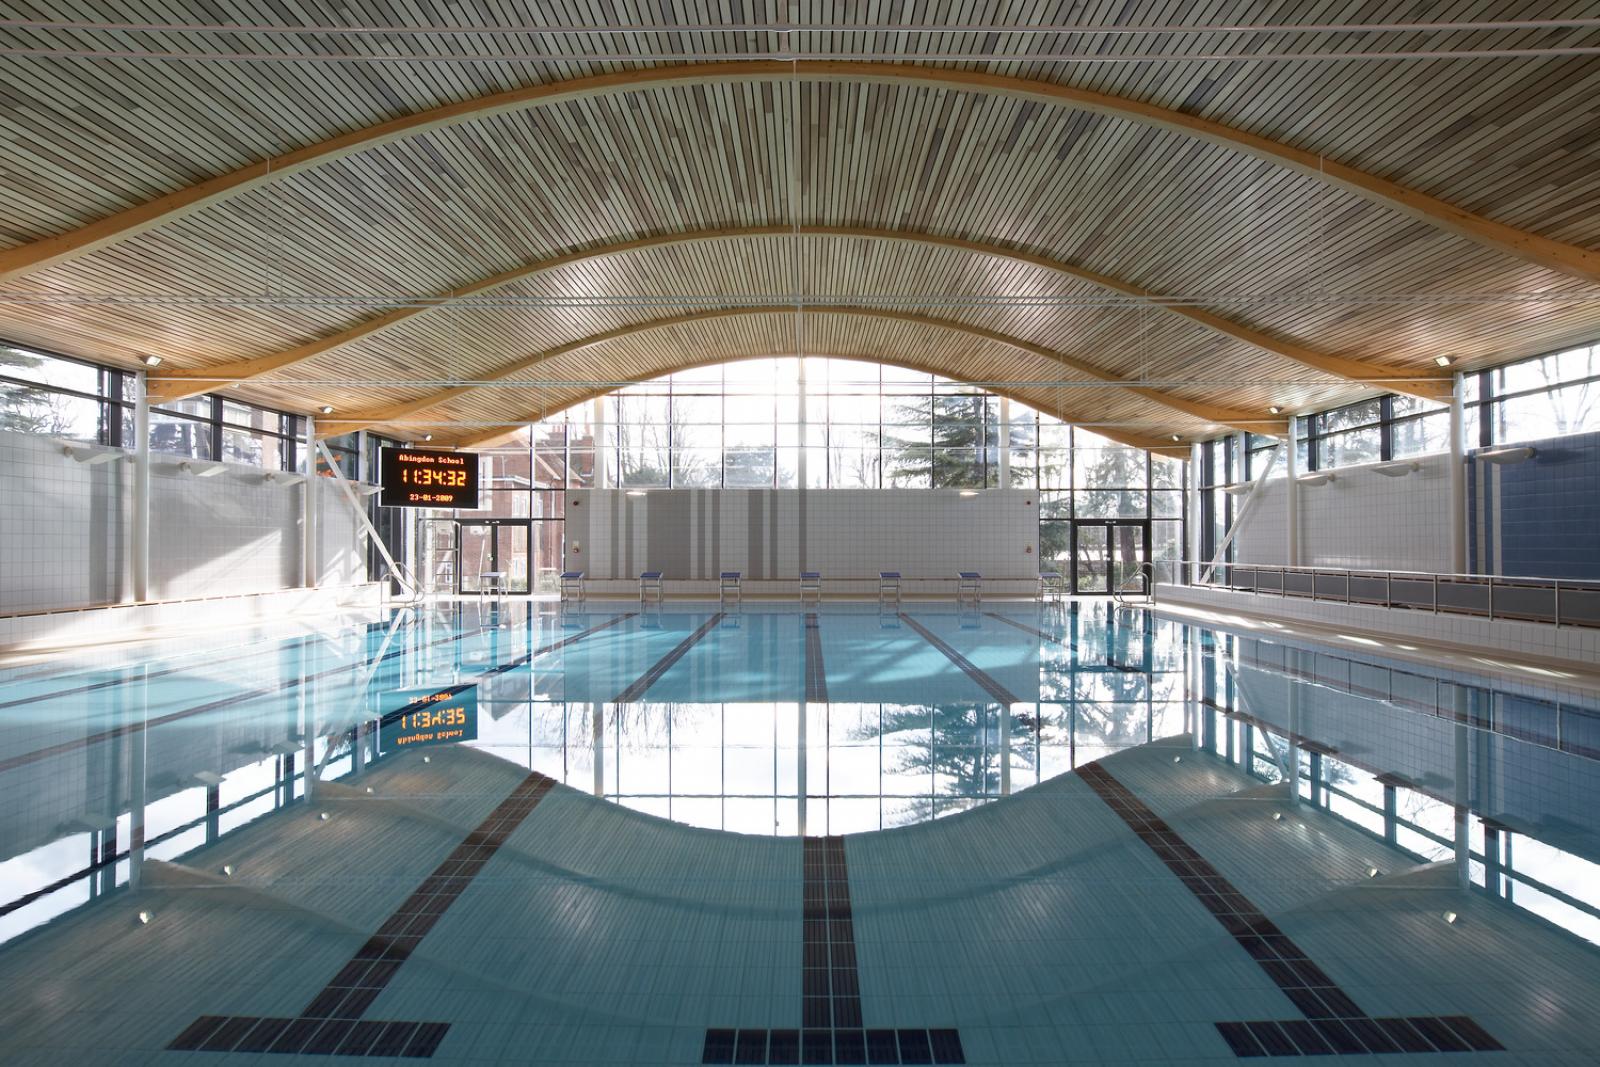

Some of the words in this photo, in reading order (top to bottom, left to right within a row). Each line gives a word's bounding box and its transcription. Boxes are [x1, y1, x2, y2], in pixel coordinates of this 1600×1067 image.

[399, 454, 435, 463] Abingdon
[438, 456, 464, 464] School
[403, 469, 466, 486] 11:34:32
[409, 494, 453, 502] 23-01-2009
